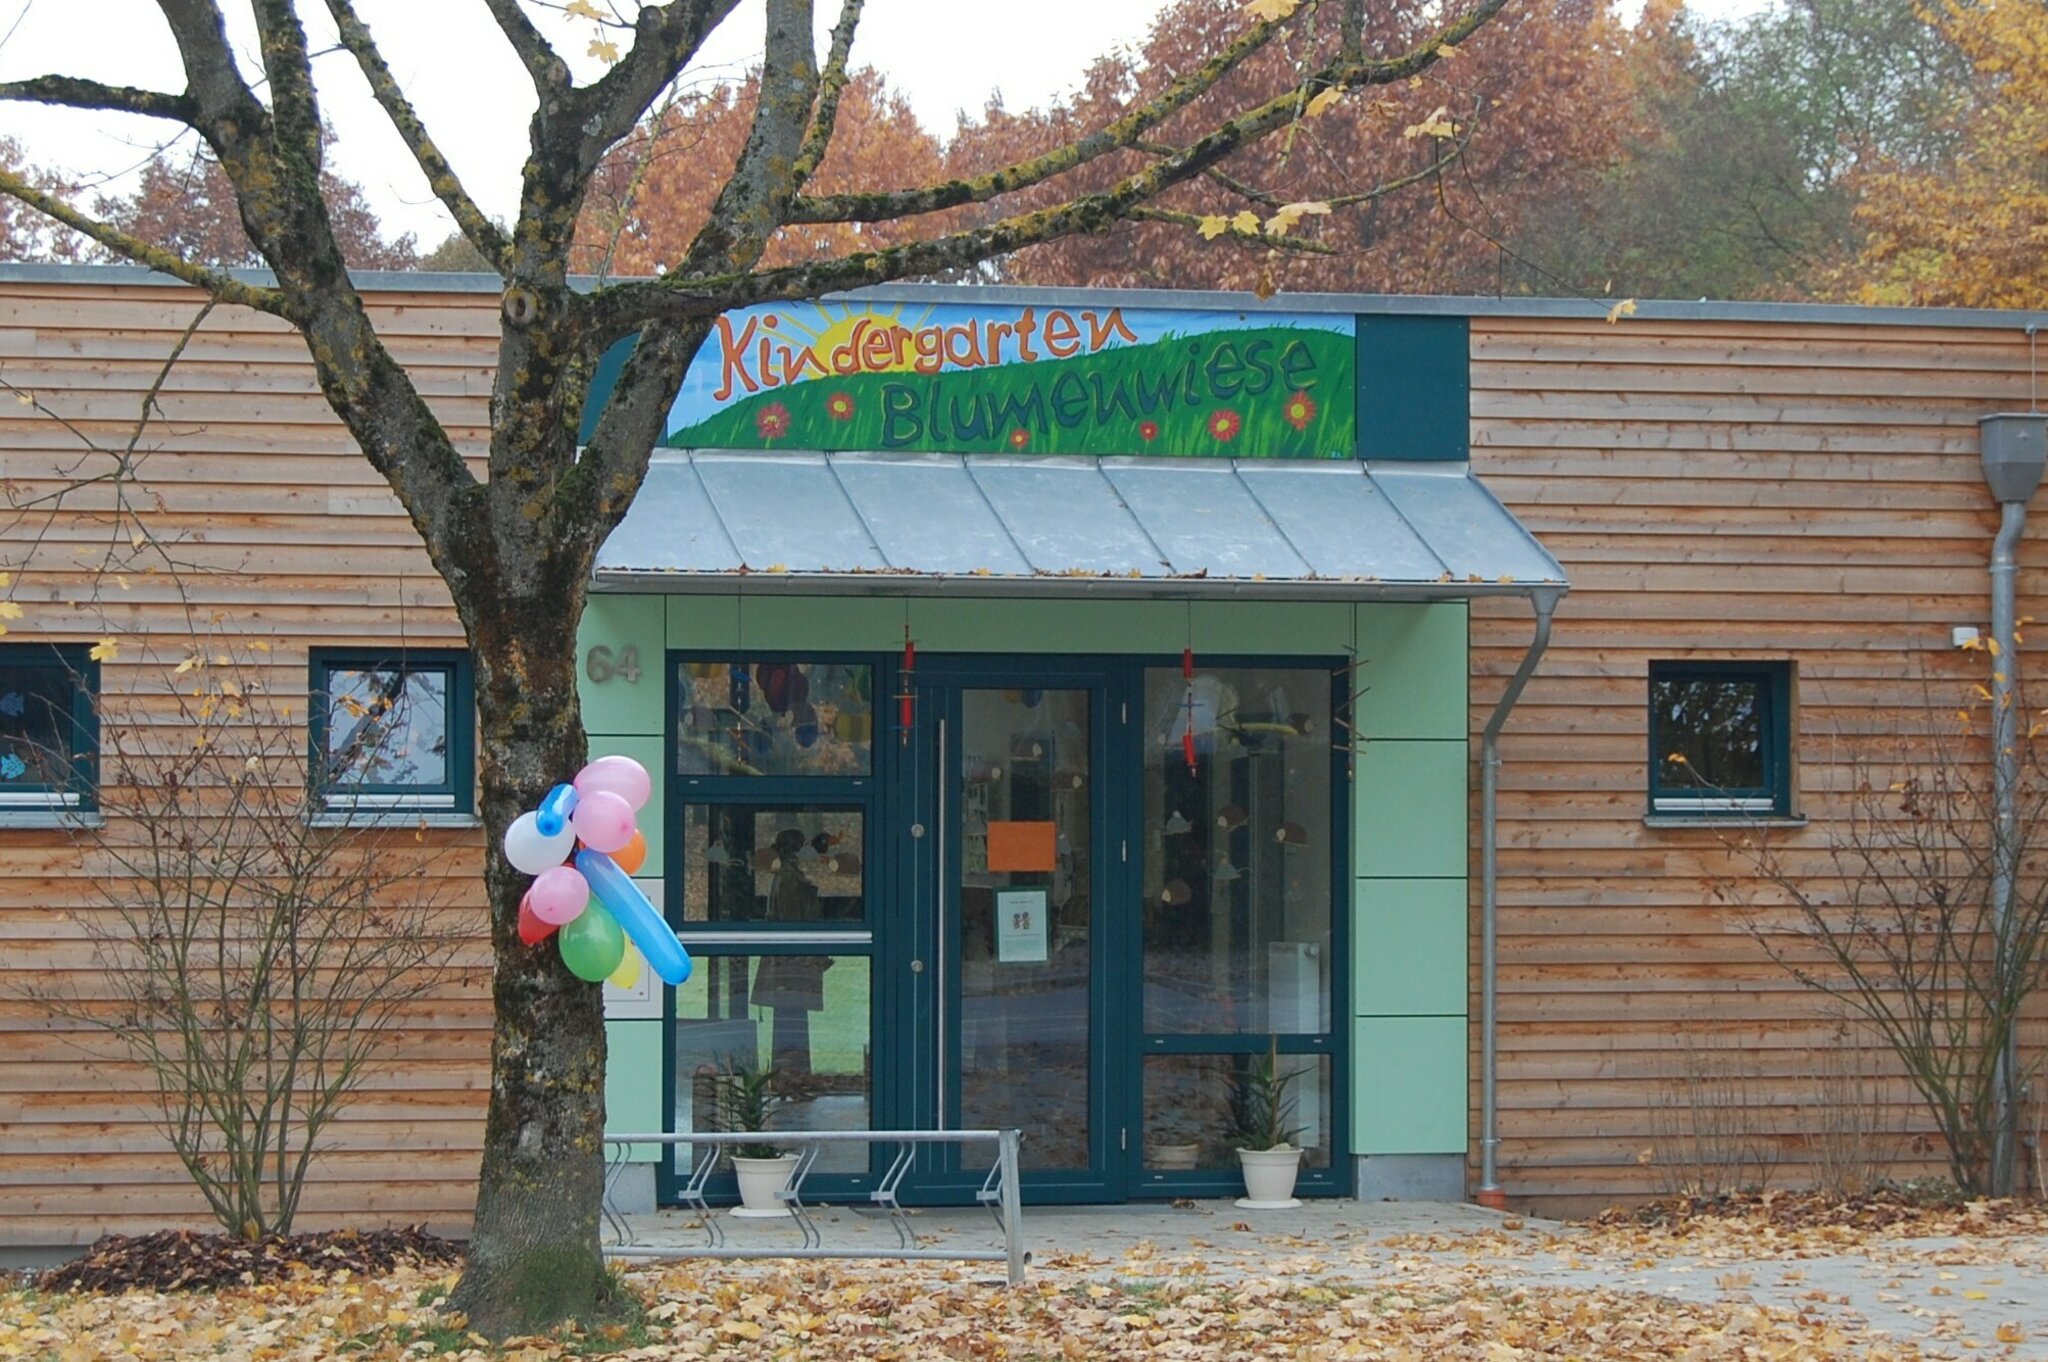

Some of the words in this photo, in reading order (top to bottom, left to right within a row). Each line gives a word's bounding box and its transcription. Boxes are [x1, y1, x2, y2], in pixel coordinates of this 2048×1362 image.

[714, 307, 1138, 400] Kindergarten
[881, 340, 1317, 447] Blumenwiese
[586, 644, 642, 684] 64
